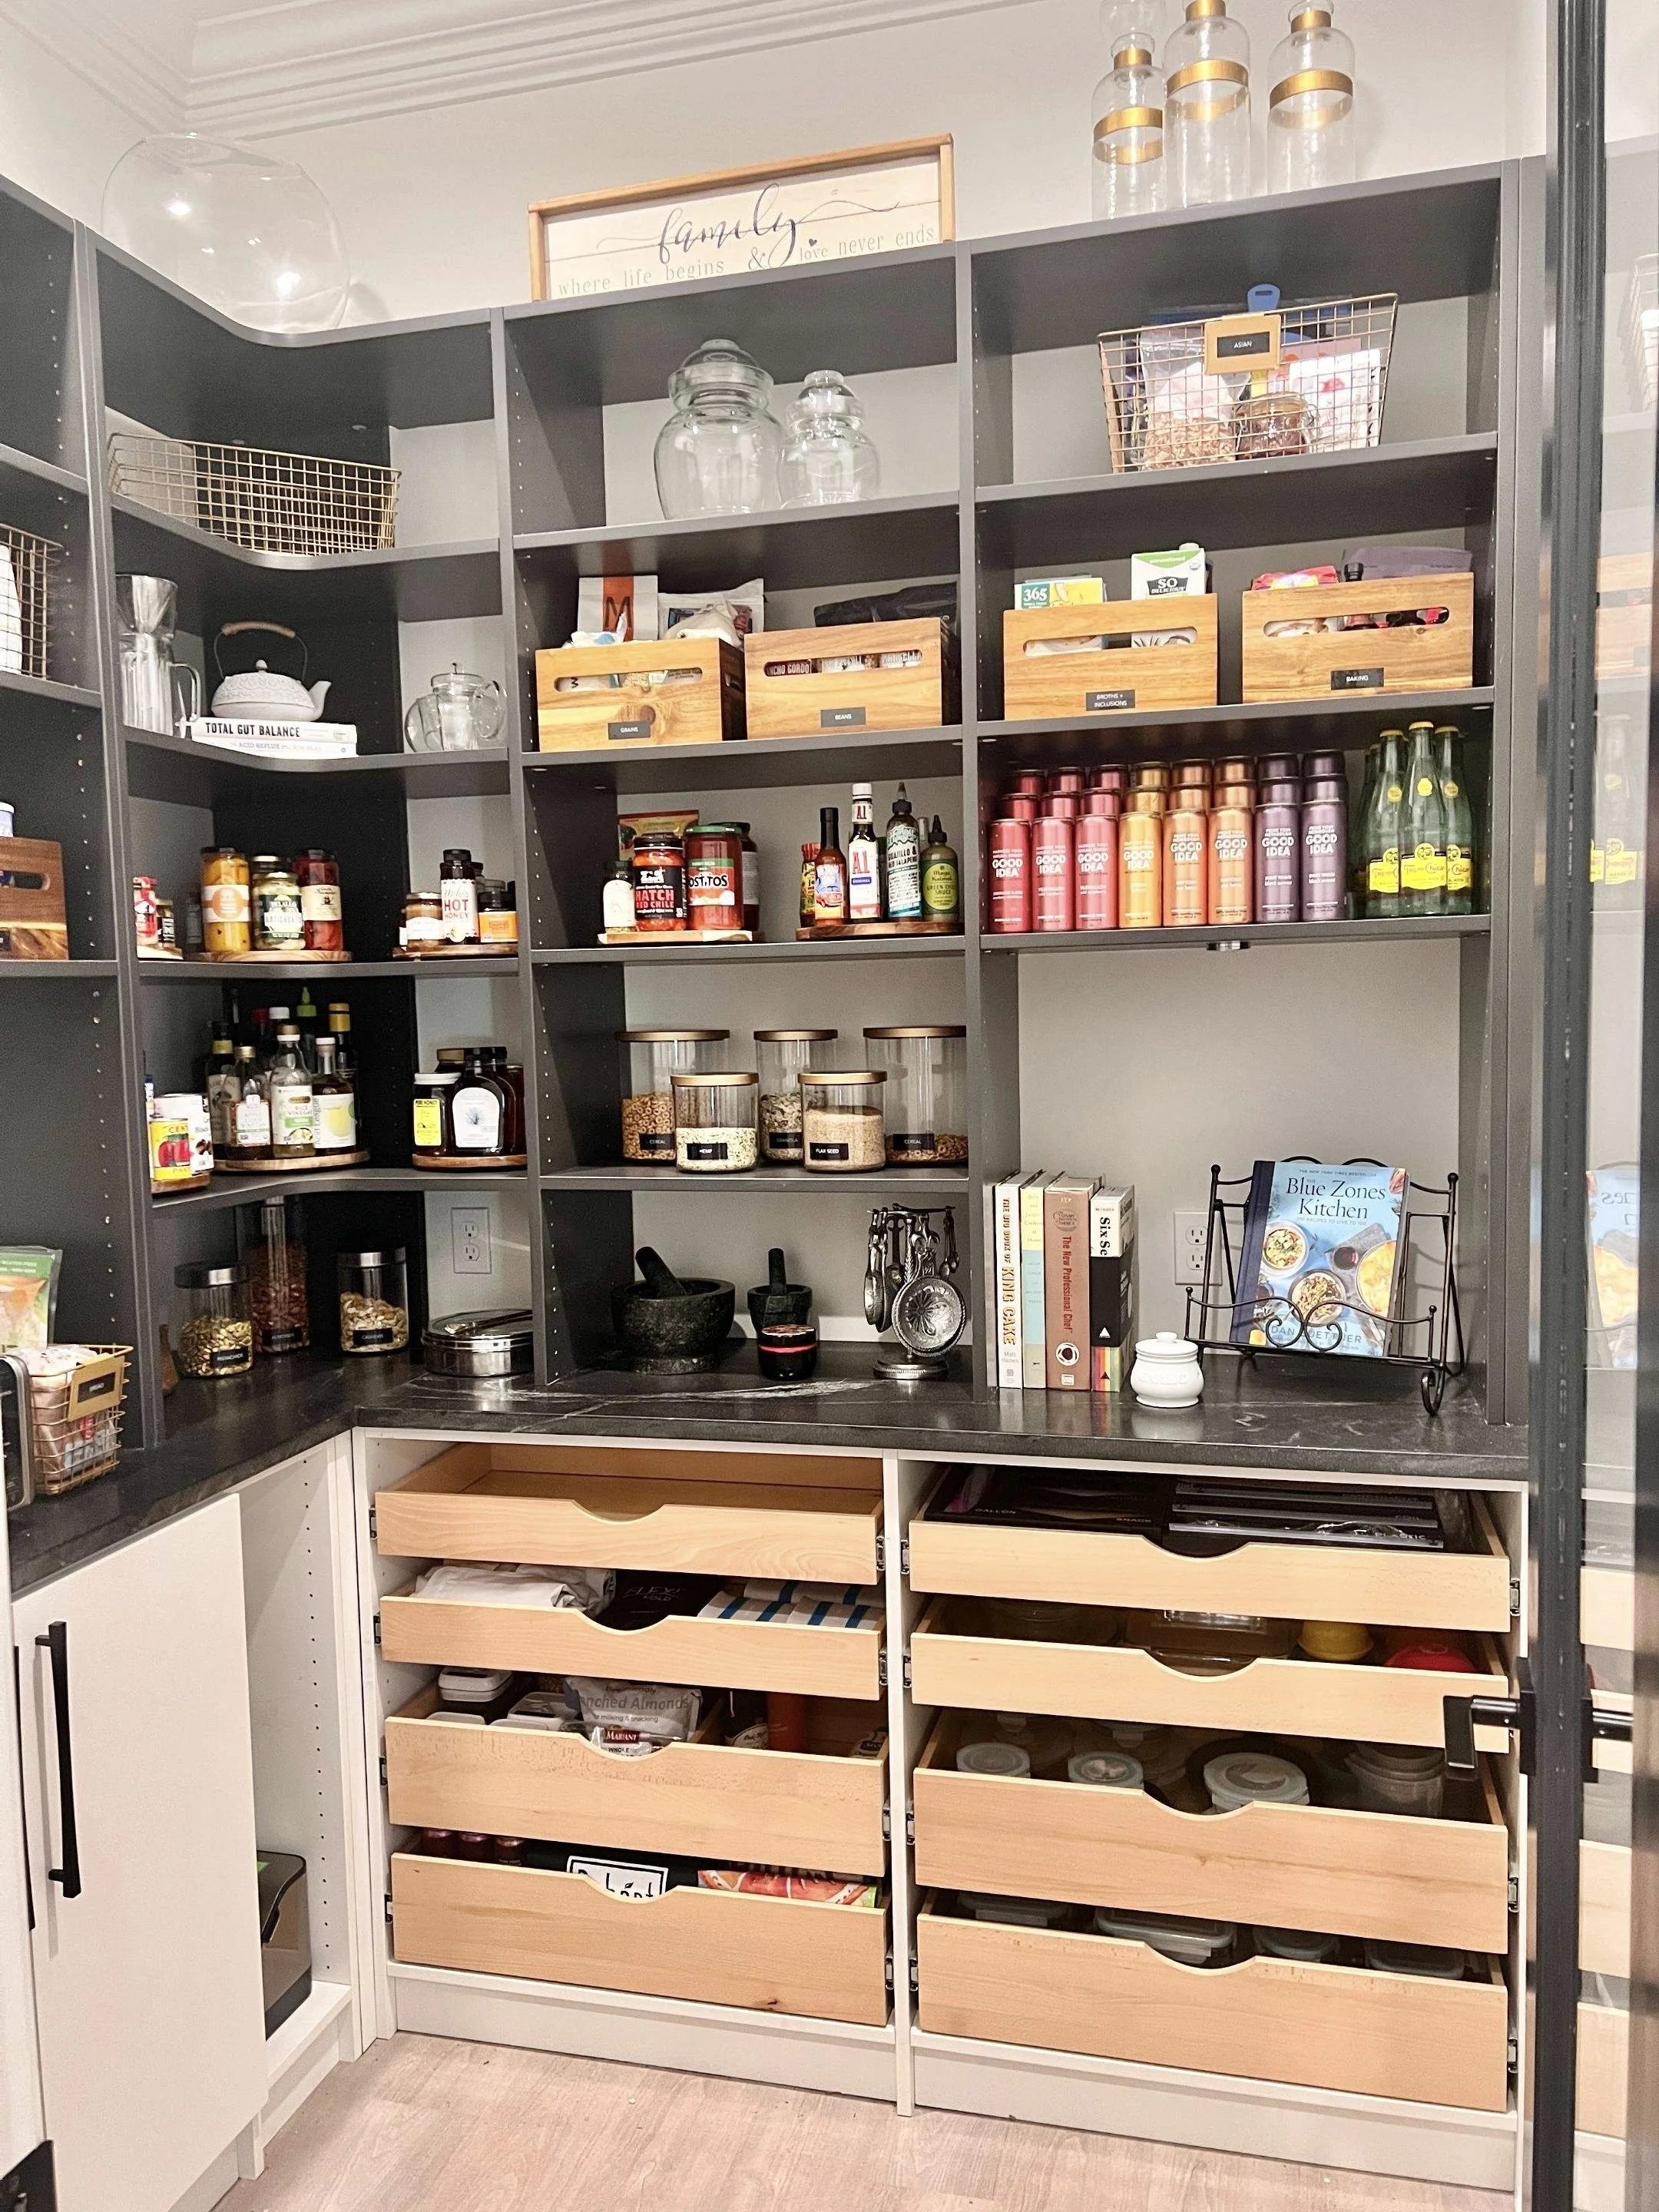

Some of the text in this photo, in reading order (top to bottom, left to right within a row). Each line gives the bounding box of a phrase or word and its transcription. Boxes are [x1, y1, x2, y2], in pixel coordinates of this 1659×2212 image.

[658, 183, 796, 269] family
[558, 224, 935, 296] where life begins & love never ends
[1233, 340, 1253, 349] ASIAN
[1158, 578, 1178, 589] SO
[1023, 588, 1048, 602] 365
[769, 664, 786, 676] NCHO
[1094, 700, 1128, 708] INCLUSIONS
[206, 723, 301, 737] TOTAL GUT BALANCE
[1215, 839, 1248, 849] GOOD
[1262, 836, 1294, 847] GOOD
[1306, 833, 1337, 845] GOOD
[1171, 842, 1203, 853] GOOD
[1266, 846, 1291, 856] IDEA
[1310, 843, 1334, 854] IDEA
[1078, 853, 1109, 863] GOOD
[1124, 850, 1154, 861] GOOD
[1174, 852, 1199, 861] IDEA
[1220, 849, 1244, 858] IDEA
[992, 859, 1023, 869] GOOD
[1035, 854, 1067, 865] GOOD
[1128, 860, 1150, 870] IDEA
[995, 868, 1019, 877] IDEA
[1039, 864, 1063, 874] IDEA
[1081, 863, 1104, 872] IDEA
[1452, 863, 1470, 875] Chico
[689, 875, 728, 889] OSTITOS
[636, 889, 674, 902] HATCH
[444, 899, 469, 912] HOT
[1286, 1177, 1386, 1200] Blue Zones
[1298, 1198, 1368, 1219] Kitchen
[1100, 1217, 1111, 1238] Six
[1002, 1267, 1015, 1303] KING
[1062, 1237, 1073, 1333] The New Professional Chef
[1003, 1306, 1016, 1345] CAKE
[1270, 1325, 1363, 1343] DAN UETTER
[581, 1696, 690, 1710] anched Almonds
